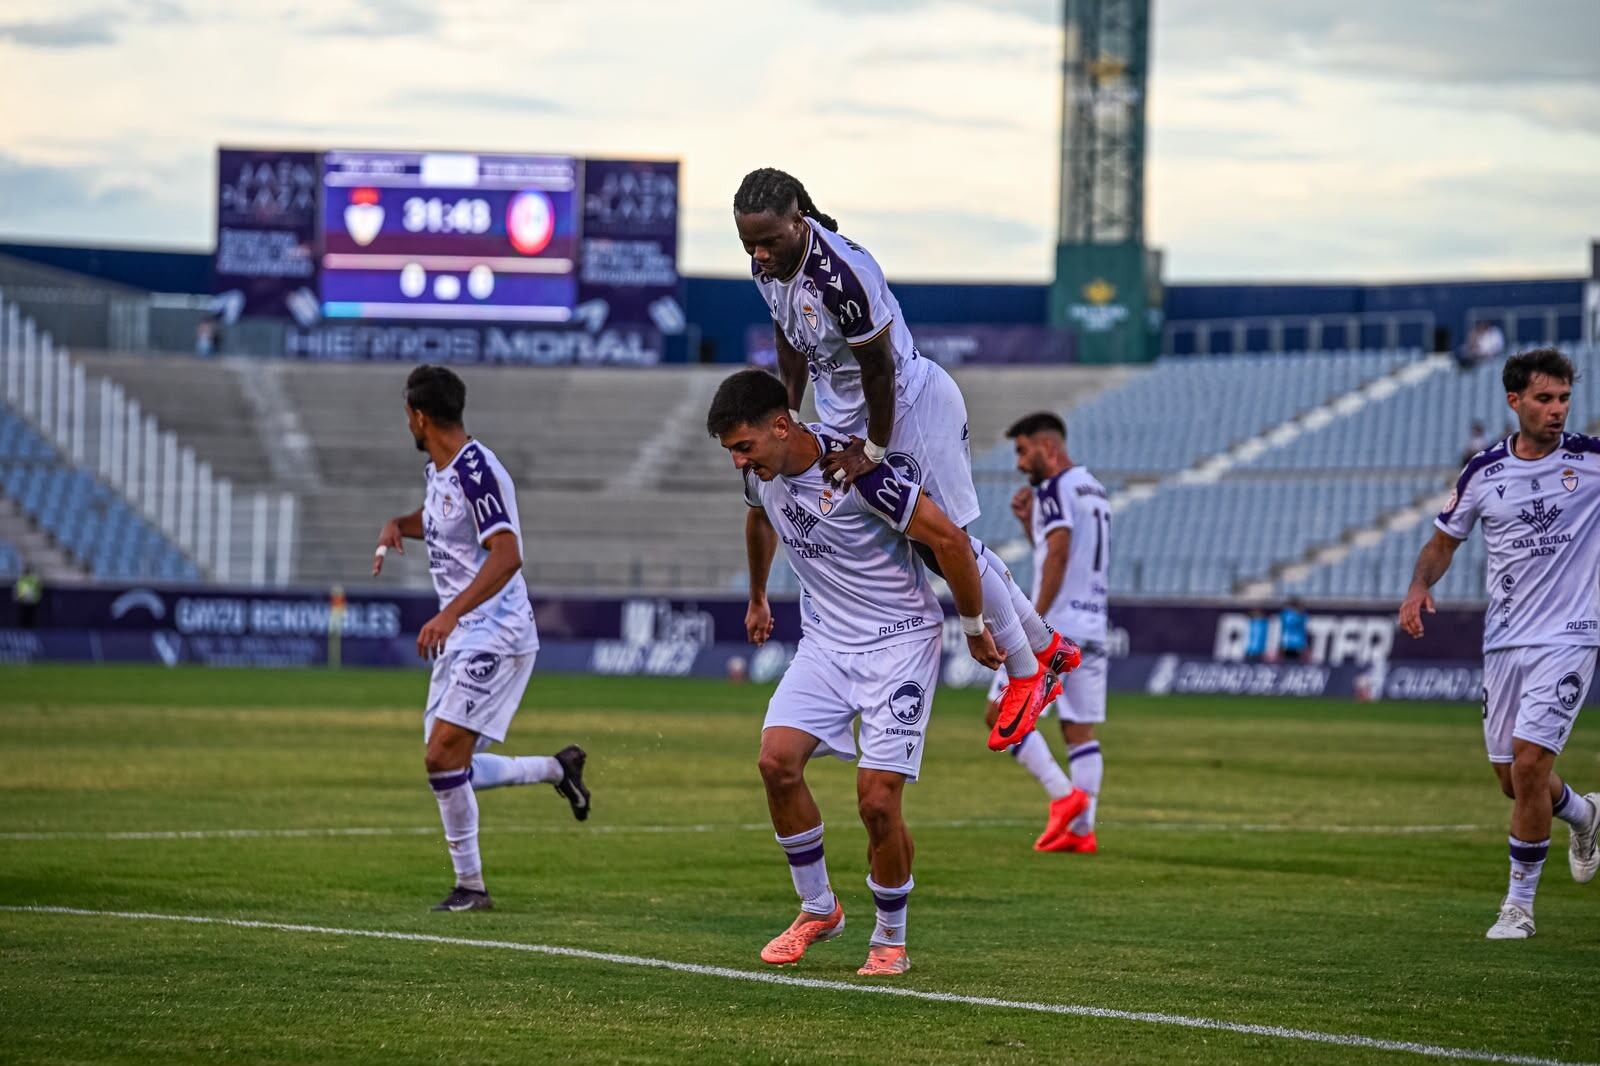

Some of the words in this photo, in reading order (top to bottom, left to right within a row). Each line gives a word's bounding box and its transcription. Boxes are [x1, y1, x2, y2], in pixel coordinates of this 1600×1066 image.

[1512, 539, 1536, 549] CAJA
[1539, 533, 1572, 546] RURAL
[879, 616, 925, 636] RUSTER
